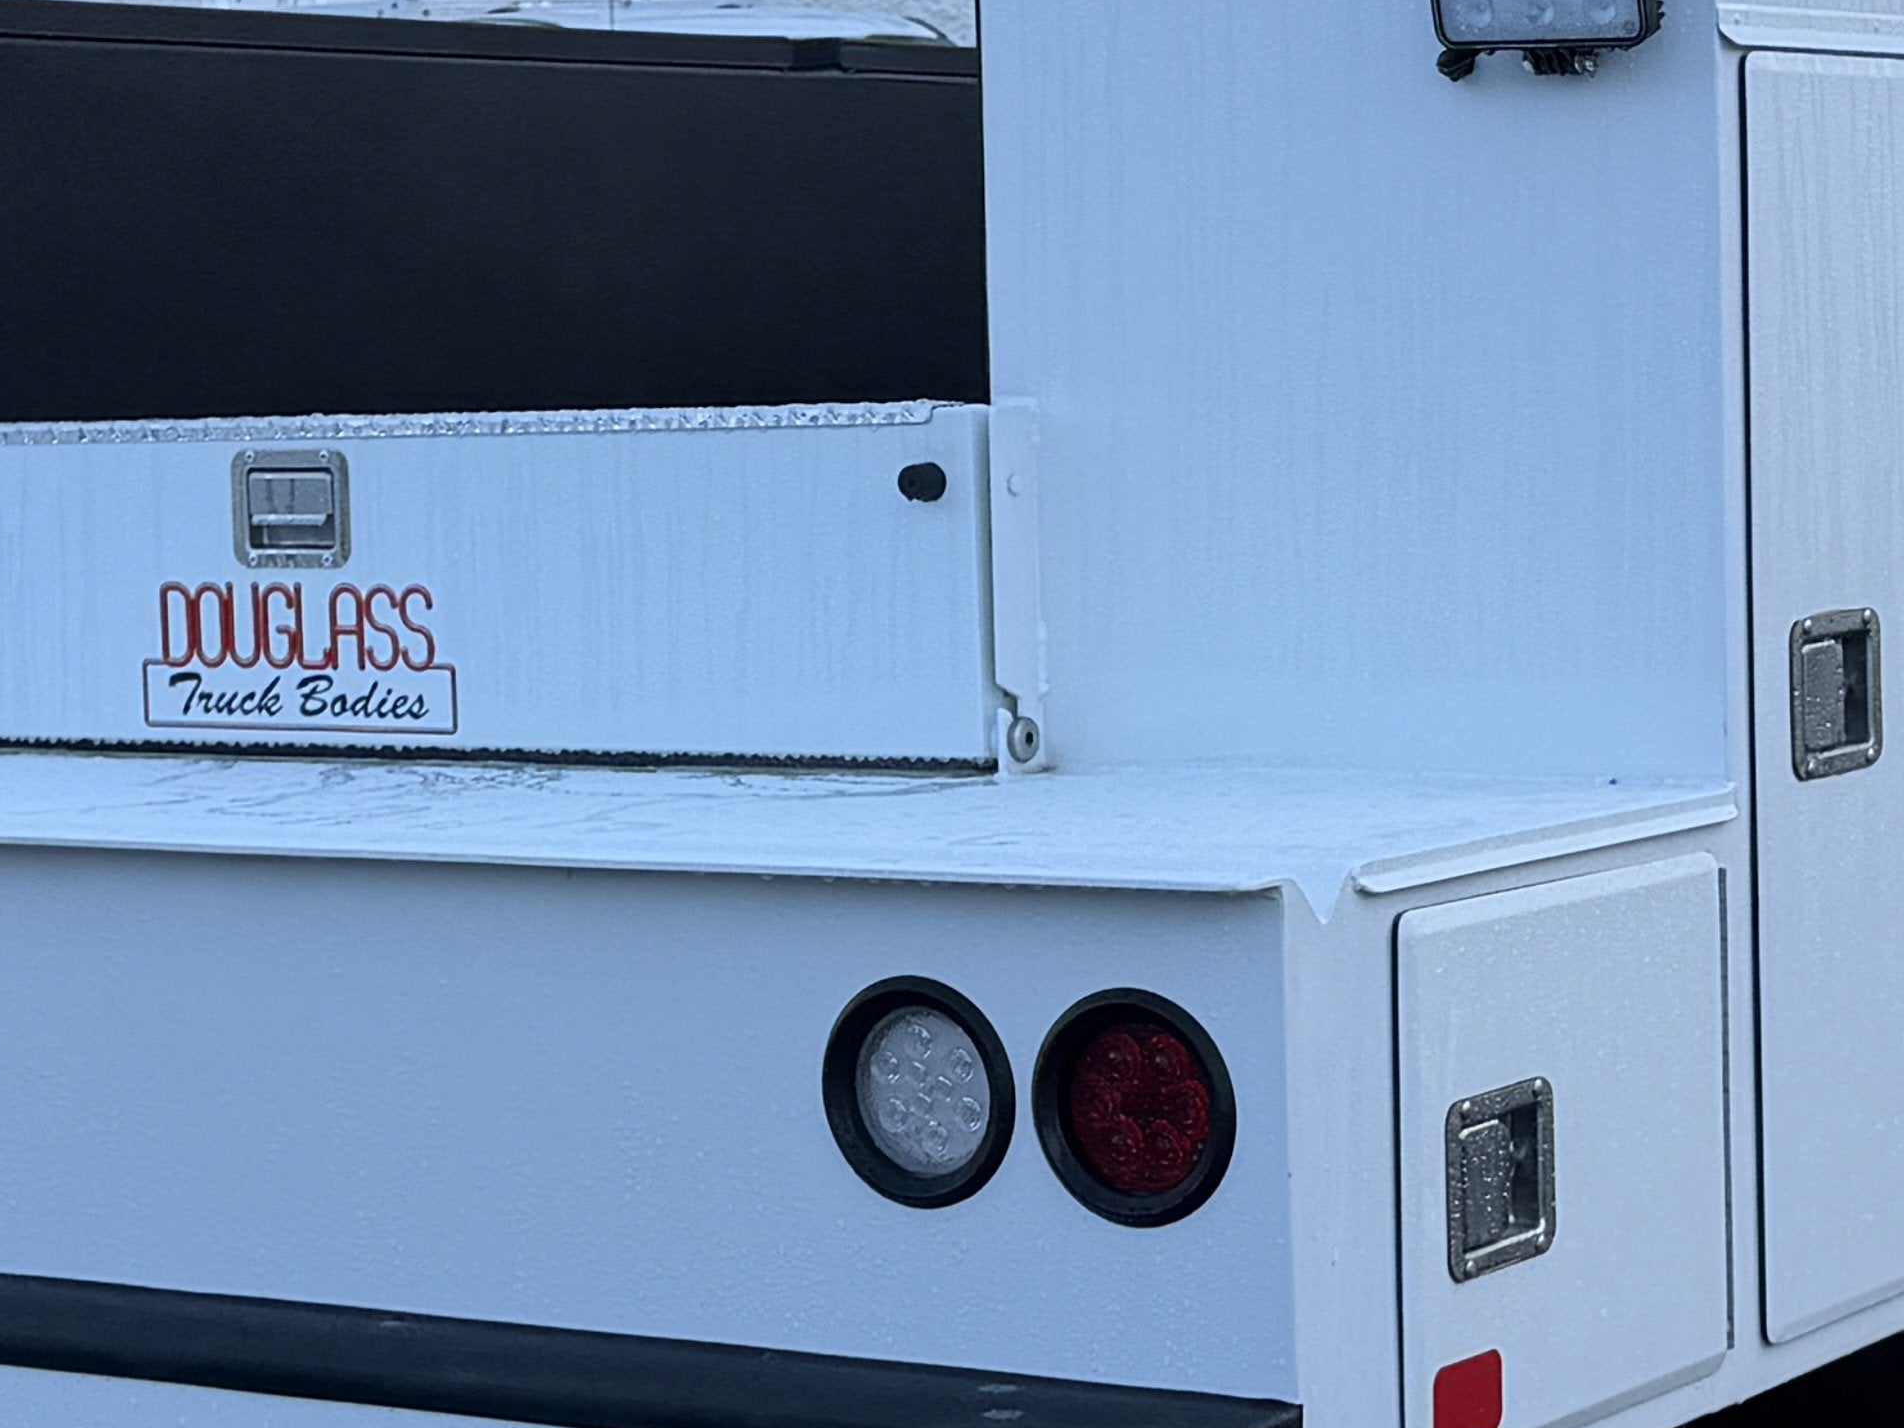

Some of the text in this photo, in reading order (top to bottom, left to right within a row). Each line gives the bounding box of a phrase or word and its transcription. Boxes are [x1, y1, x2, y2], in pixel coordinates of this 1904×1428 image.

[158, 581, 435, 671] DOUGLASS
[168, 672, 430, 720] Truck Bodies
